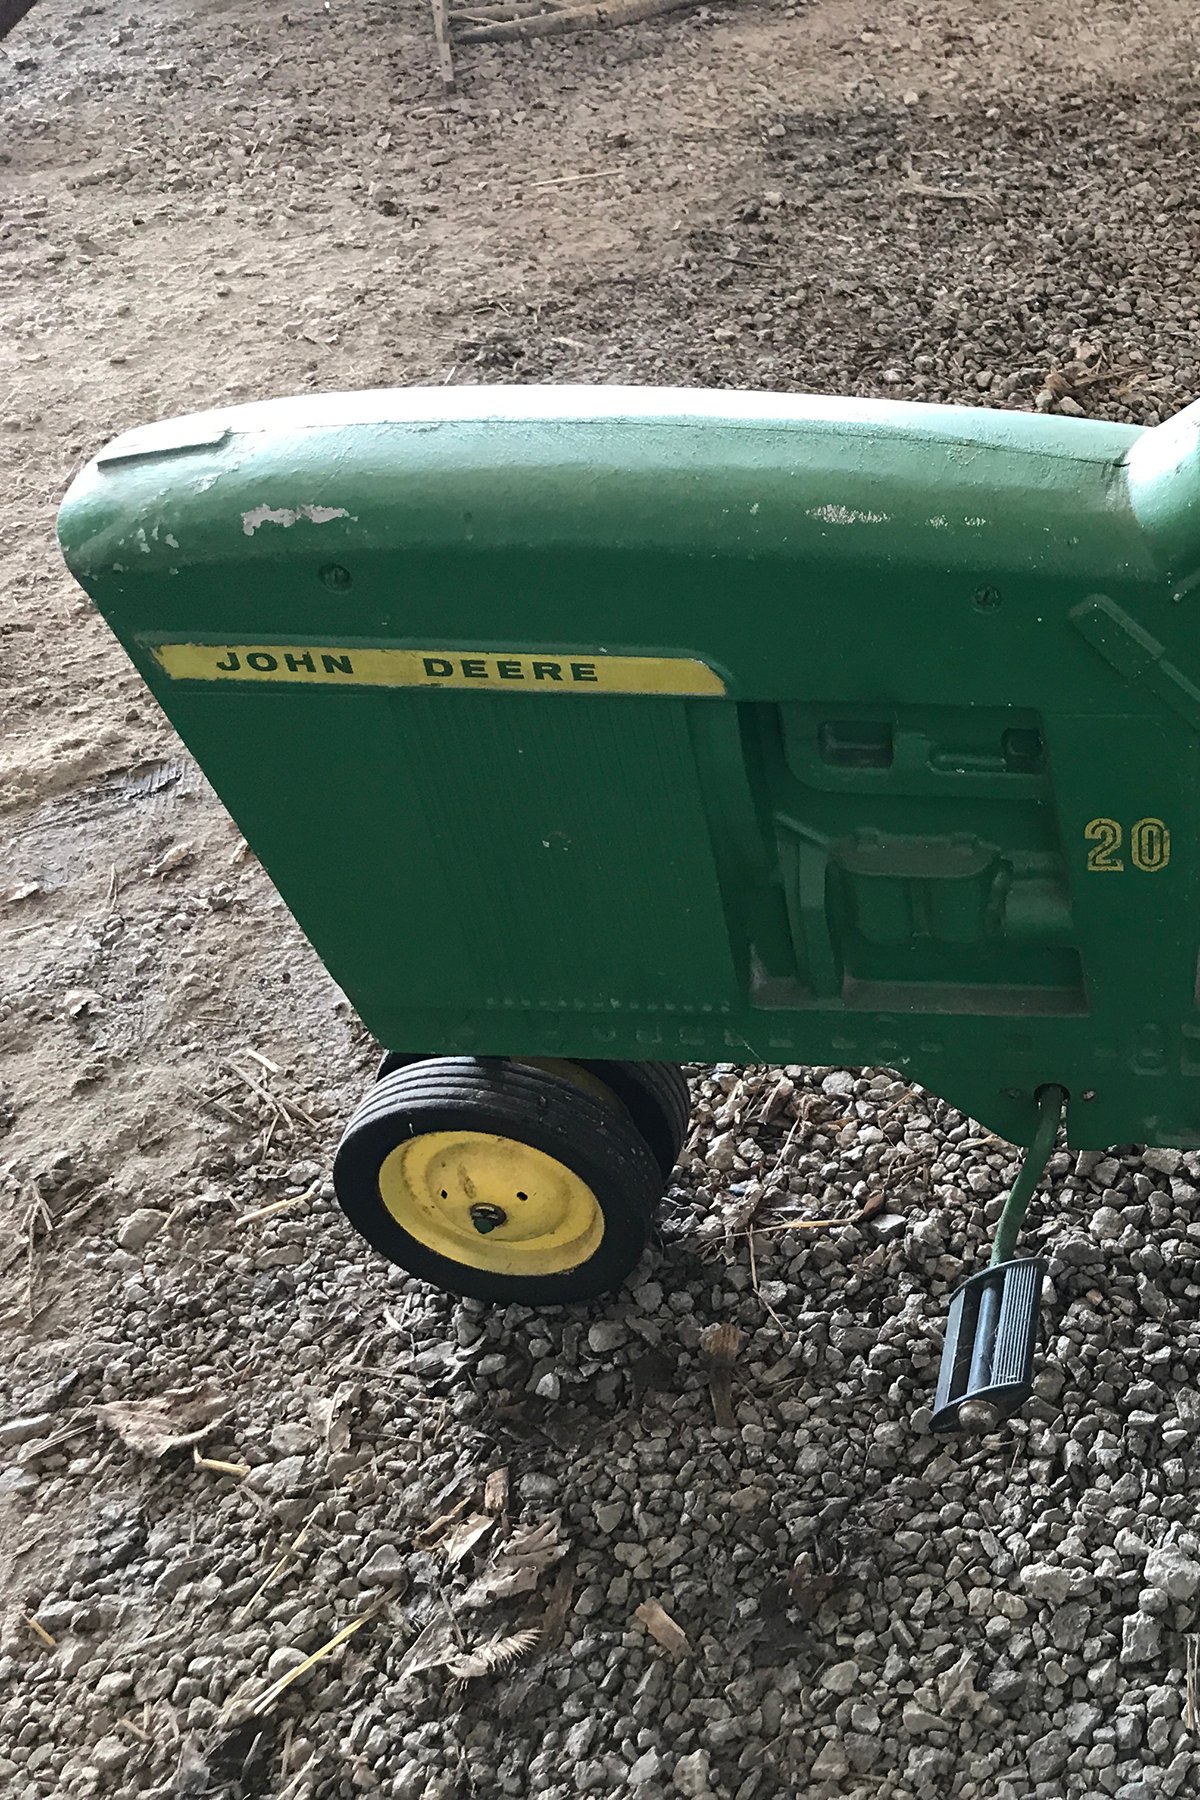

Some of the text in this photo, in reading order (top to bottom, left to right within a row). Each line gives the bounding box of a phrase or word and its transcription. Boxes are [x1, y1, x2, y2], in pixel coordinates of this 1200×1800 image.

[216, 651, 598, 682] JOHN DEERE
[1085, 817, 1171, 872] 20
